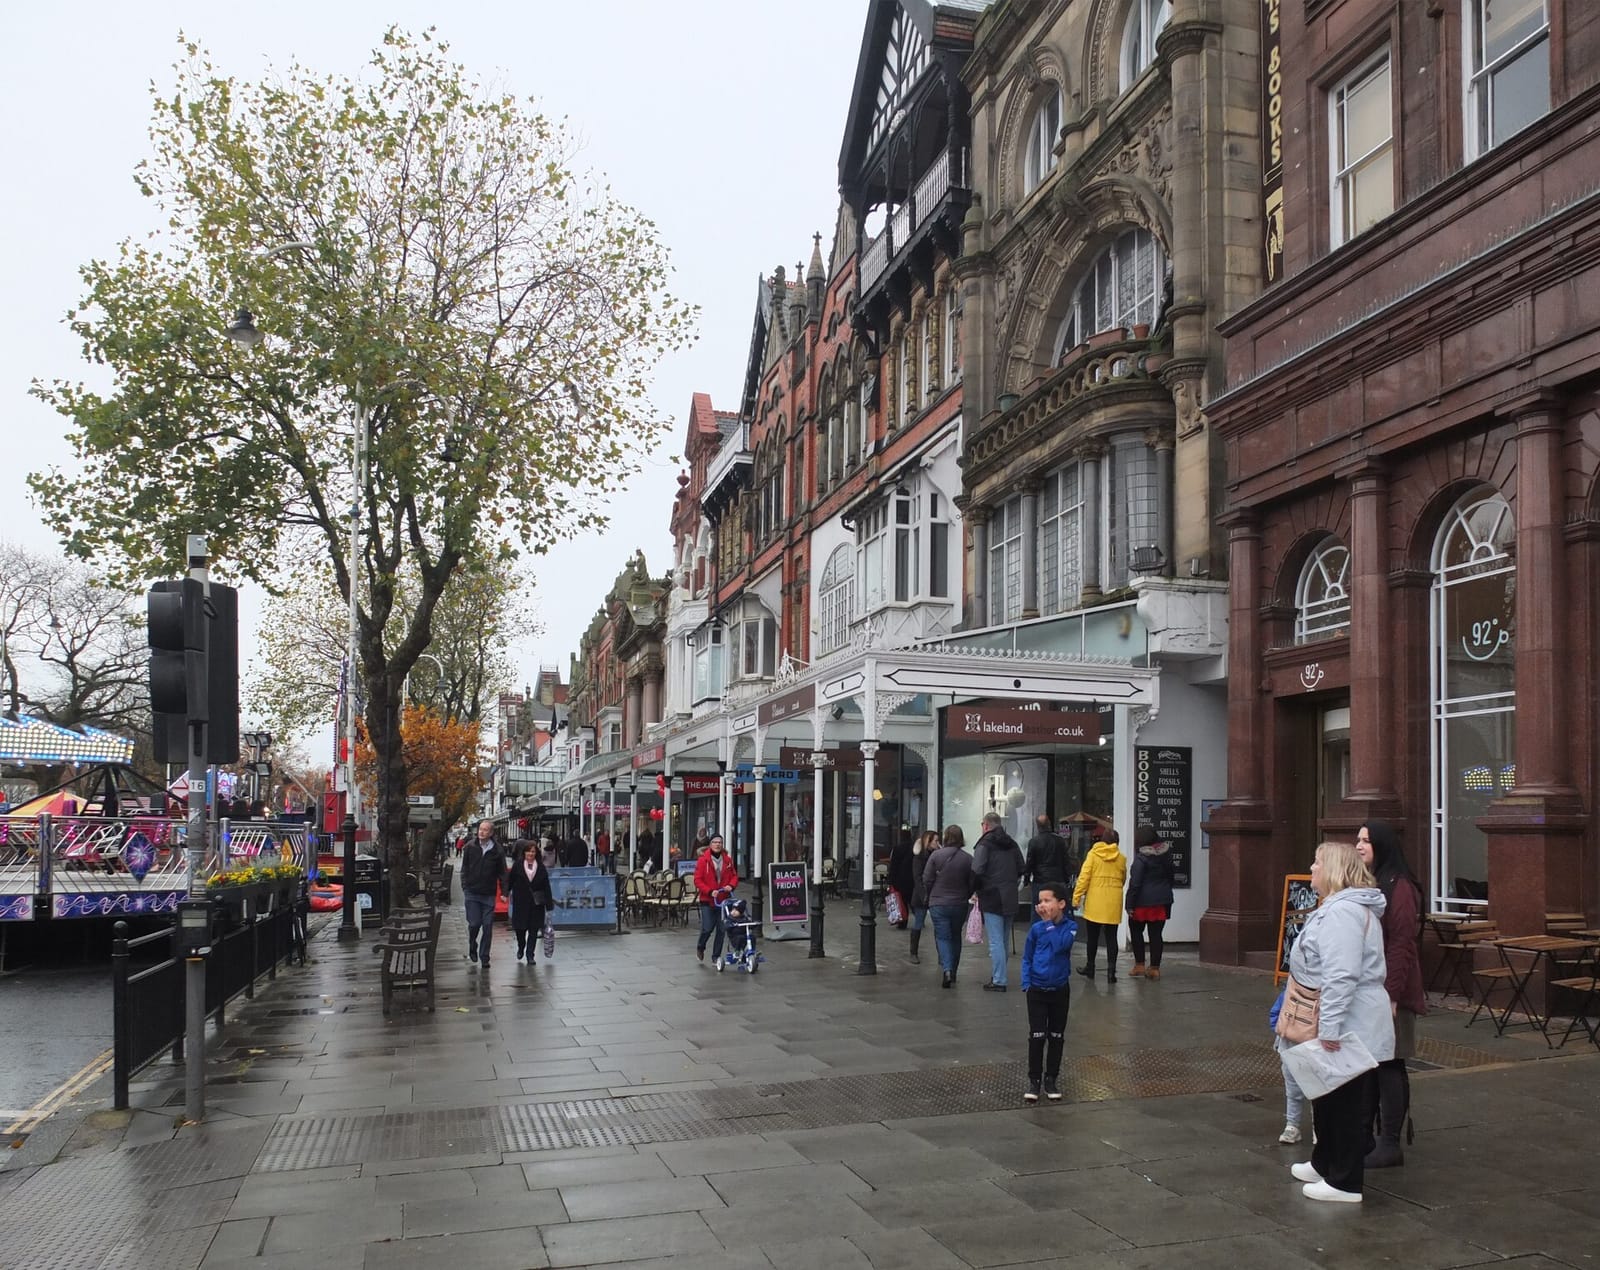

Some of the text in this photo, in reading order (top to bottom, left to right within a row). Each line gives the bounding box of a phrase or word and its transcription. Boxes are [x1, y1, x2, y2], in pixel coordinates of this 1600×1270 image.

[1268, 45, 1282, 165] BOOKS
[1159, 767, 1180, 776] SHELLS
[1137, 750, 1150, 803] BOOKS
[191, 781, 204, 791] 16
[685, 781, 700, 789] THE
[702, 781, 720, 789] XMA
[1158, 777, 1181, 786] FOSSILS
[1156, 787, 1183, 796] CRYSTALS
[1157, 797, 1182, 806] RECORDS
[775, 870, 801, 880] BLACK
[776, 881, 801, 890] FRIDAY
[780, 896, 800, 906] 60%
